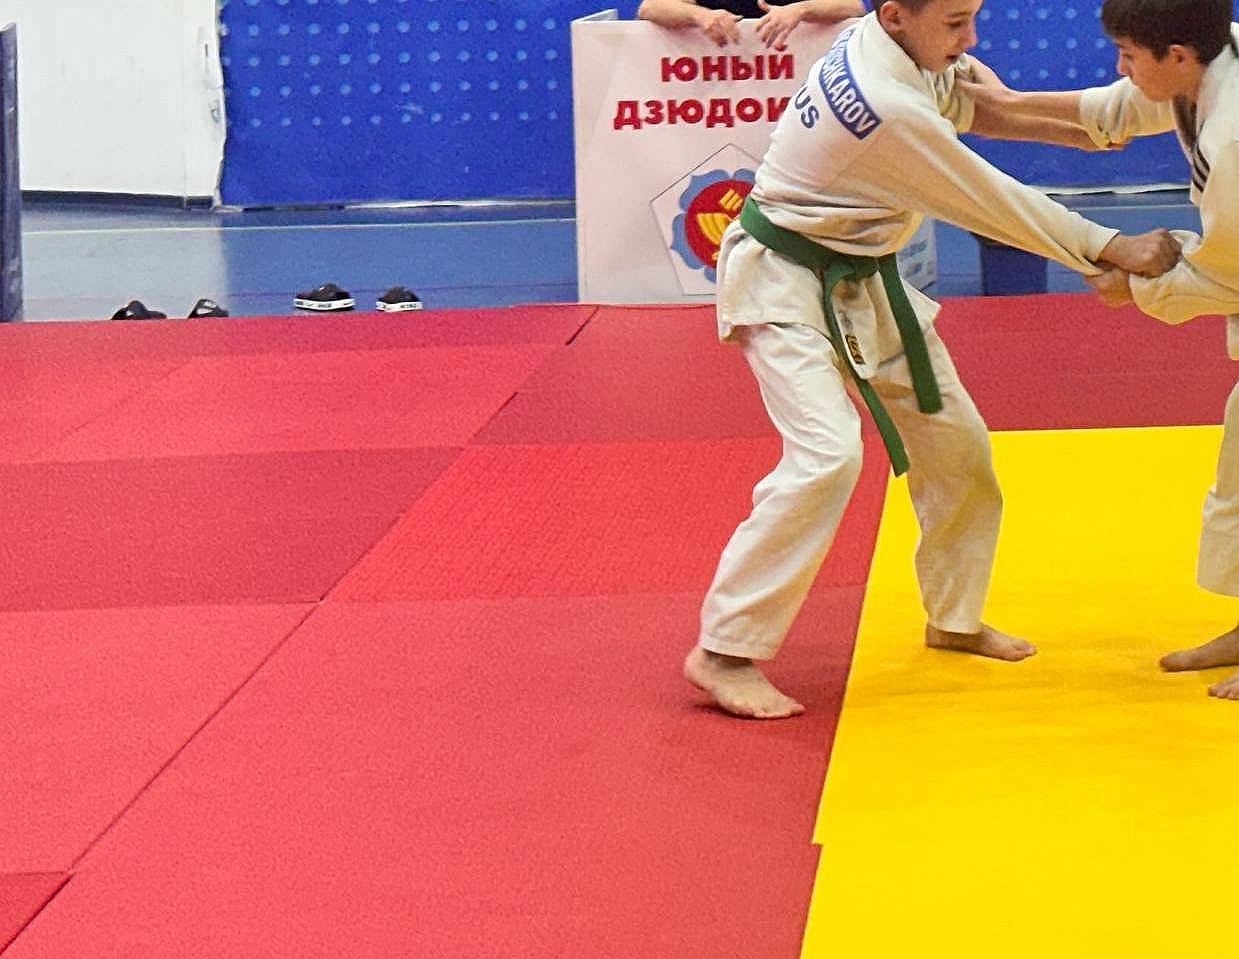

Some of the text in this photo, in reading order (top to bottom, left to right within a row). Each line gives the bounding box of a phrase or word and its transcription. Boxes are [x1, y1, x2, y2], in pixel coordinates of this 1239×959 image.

[660, 44, 794, 83] ЮНЫЙ
[612, 95, 789, 130] ДЗЮДОИ
[794, 83, 819, 129] US
